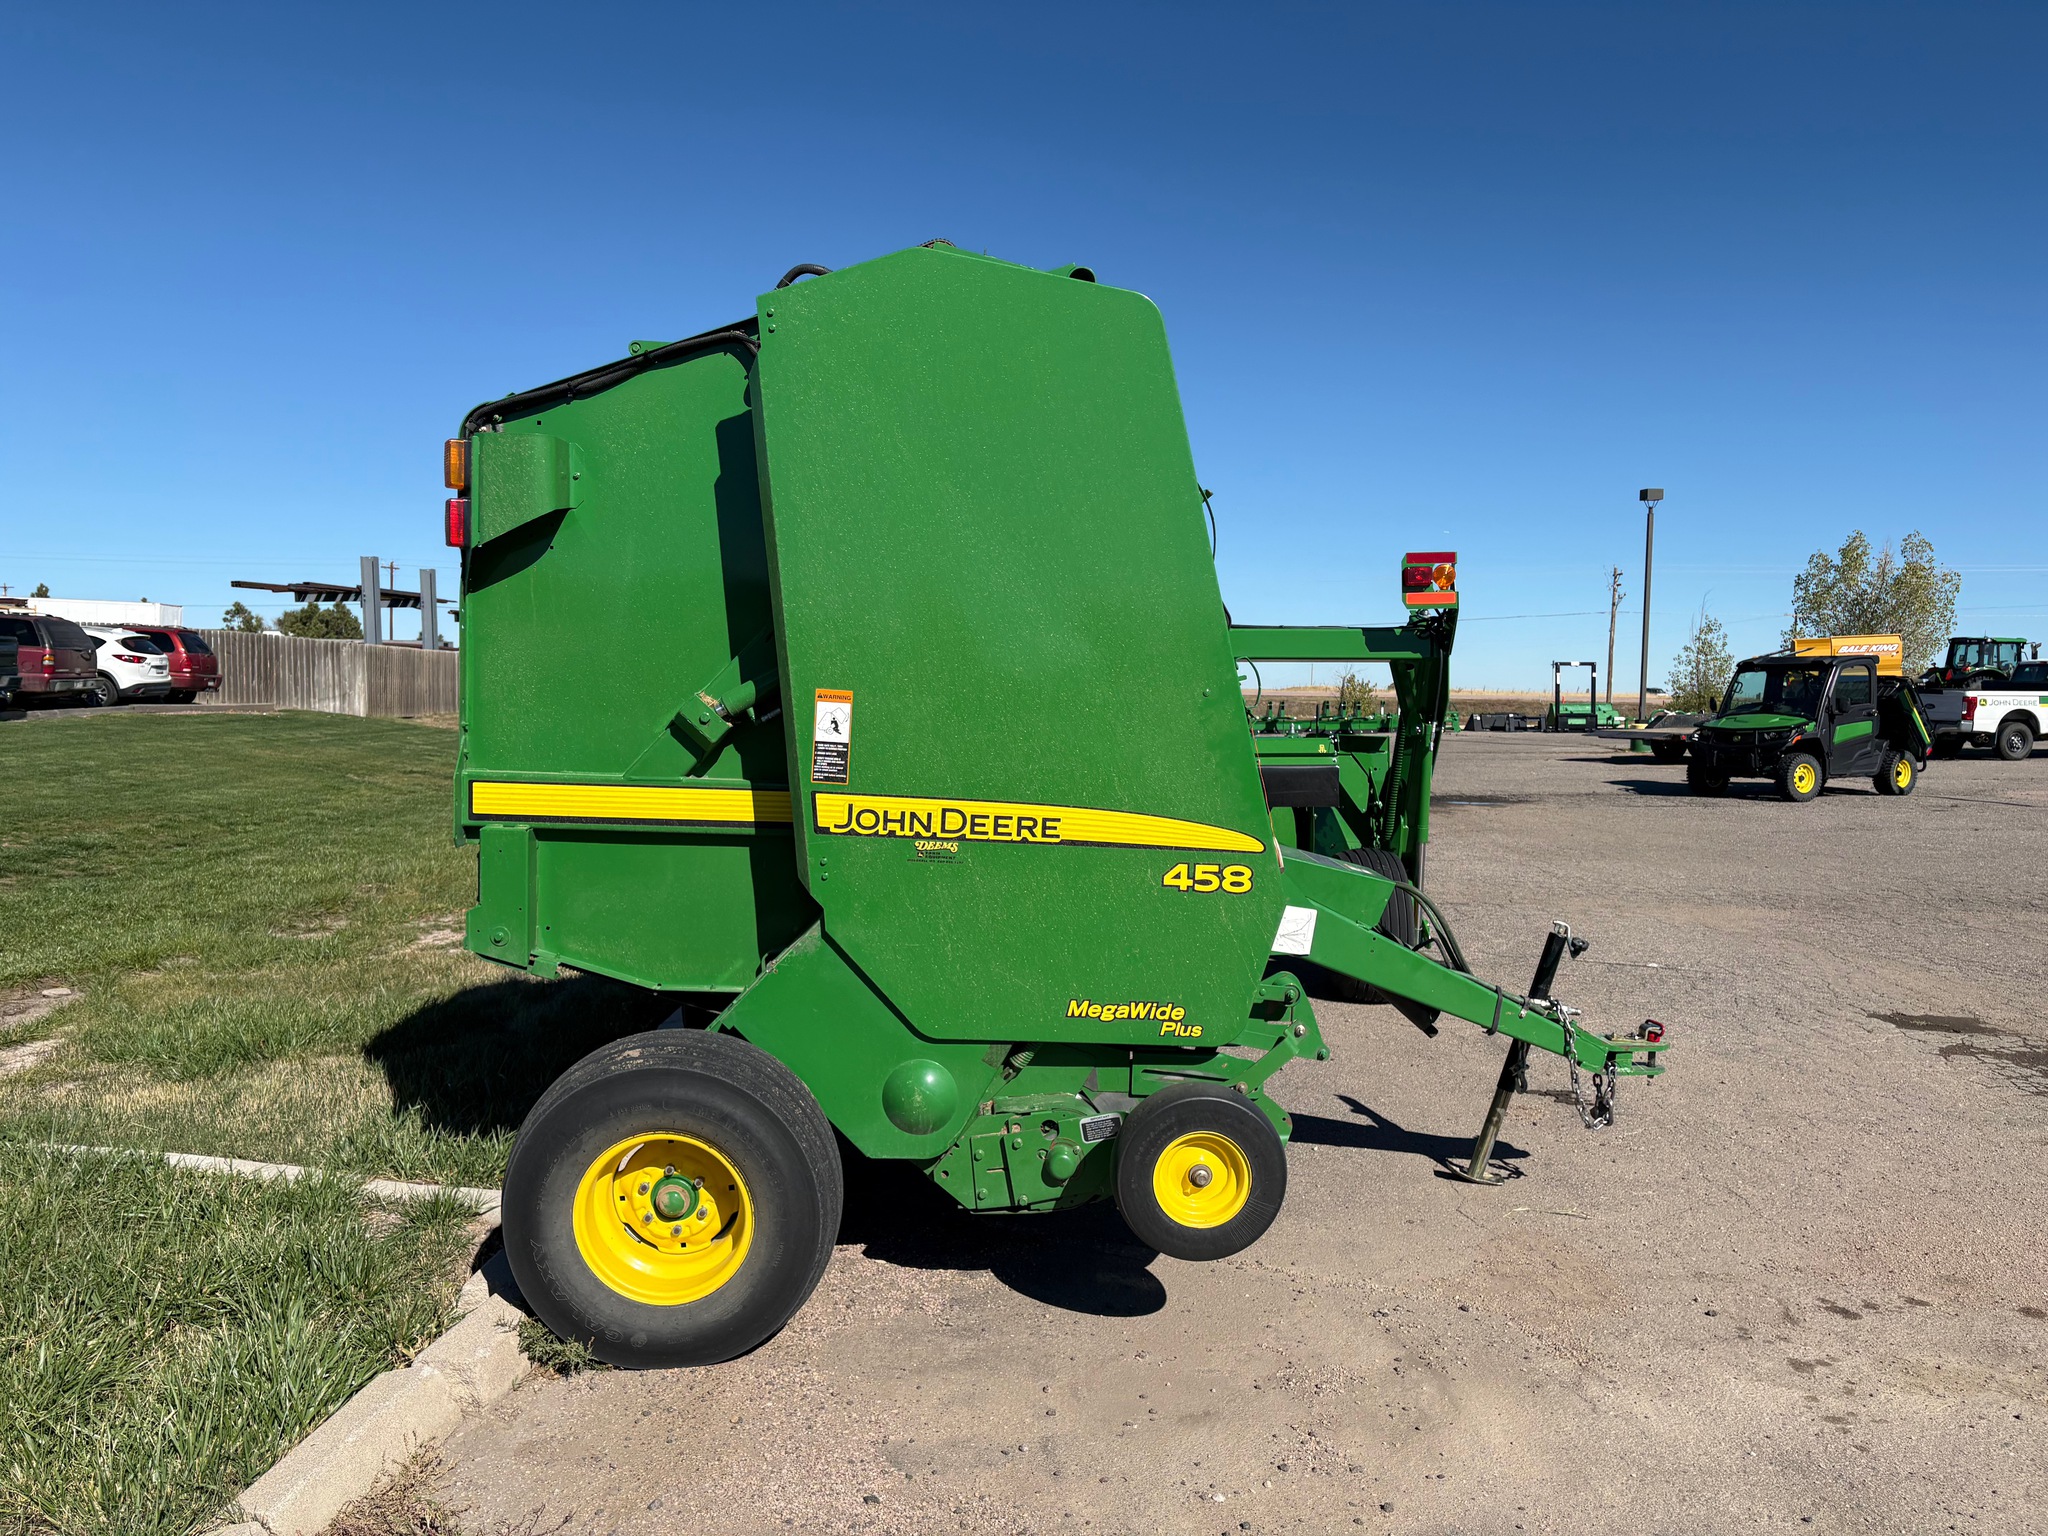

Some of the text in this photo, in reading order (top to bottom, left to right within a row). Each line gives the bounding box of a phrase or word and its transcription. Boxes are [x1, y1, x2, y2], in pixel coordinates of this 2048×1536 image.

[1838, 643, 1899, 654] BALE KING
[822, 693, 852, 701] WARNING
[1989, 698, 2038, 707] JOHN DEERE
[833, 803, 1062, 839] JOHN DEERE
[914, 840, 959, 853] DEEMS
[1162, 863, 1253, 894] 458
[1066, 999, 1186, 1022] MegaWide
[1159, 1021, 1204, 1038] Plus
